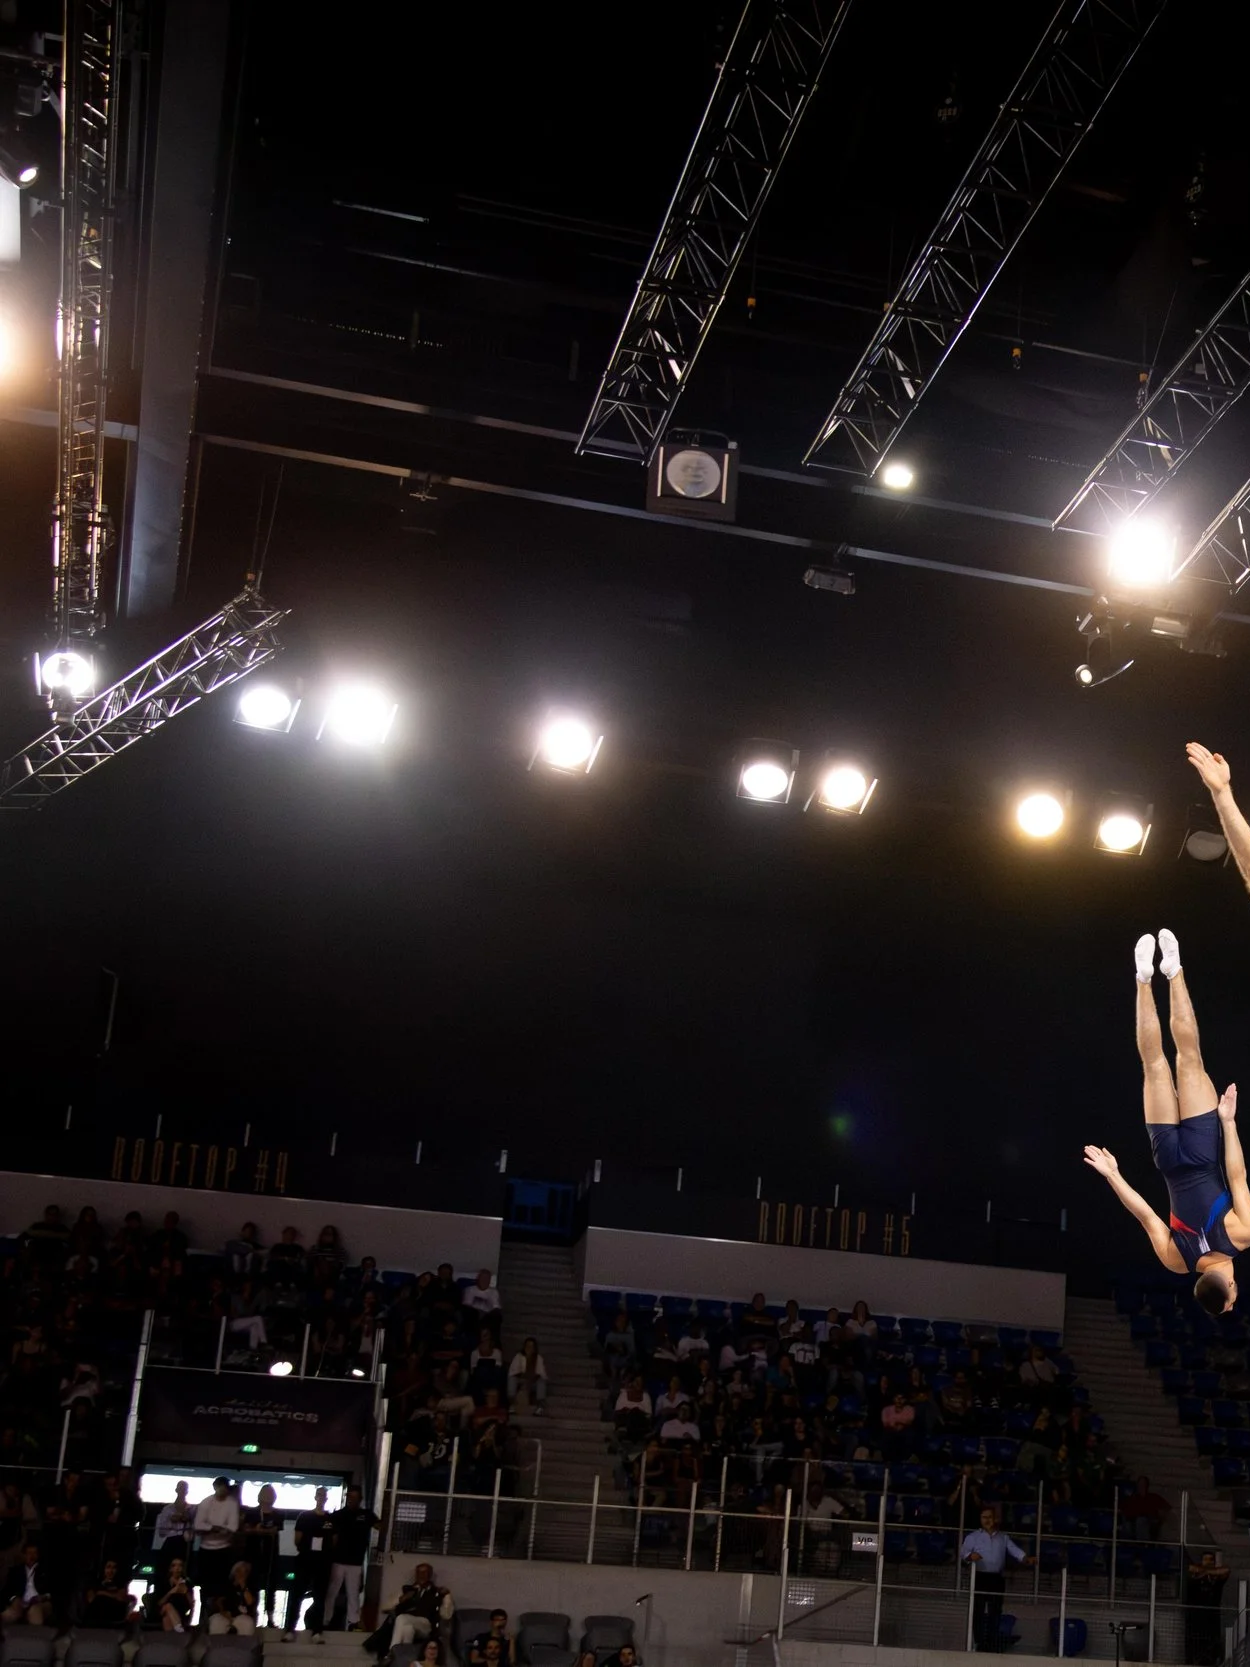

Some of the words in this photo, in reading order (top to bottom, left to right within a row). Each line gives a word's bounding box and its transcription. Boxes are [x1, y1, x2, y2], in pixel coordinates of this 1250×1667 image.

[110, 1135, 238, 1189] ROOFTOP
[253, 1149, 290, 1194] #4
[758, 1200, 867, 1253] ROOFTOP
[882, 1212, 911, 1256] #5
[192, 1404, 319, 1423] ACROBATICS
